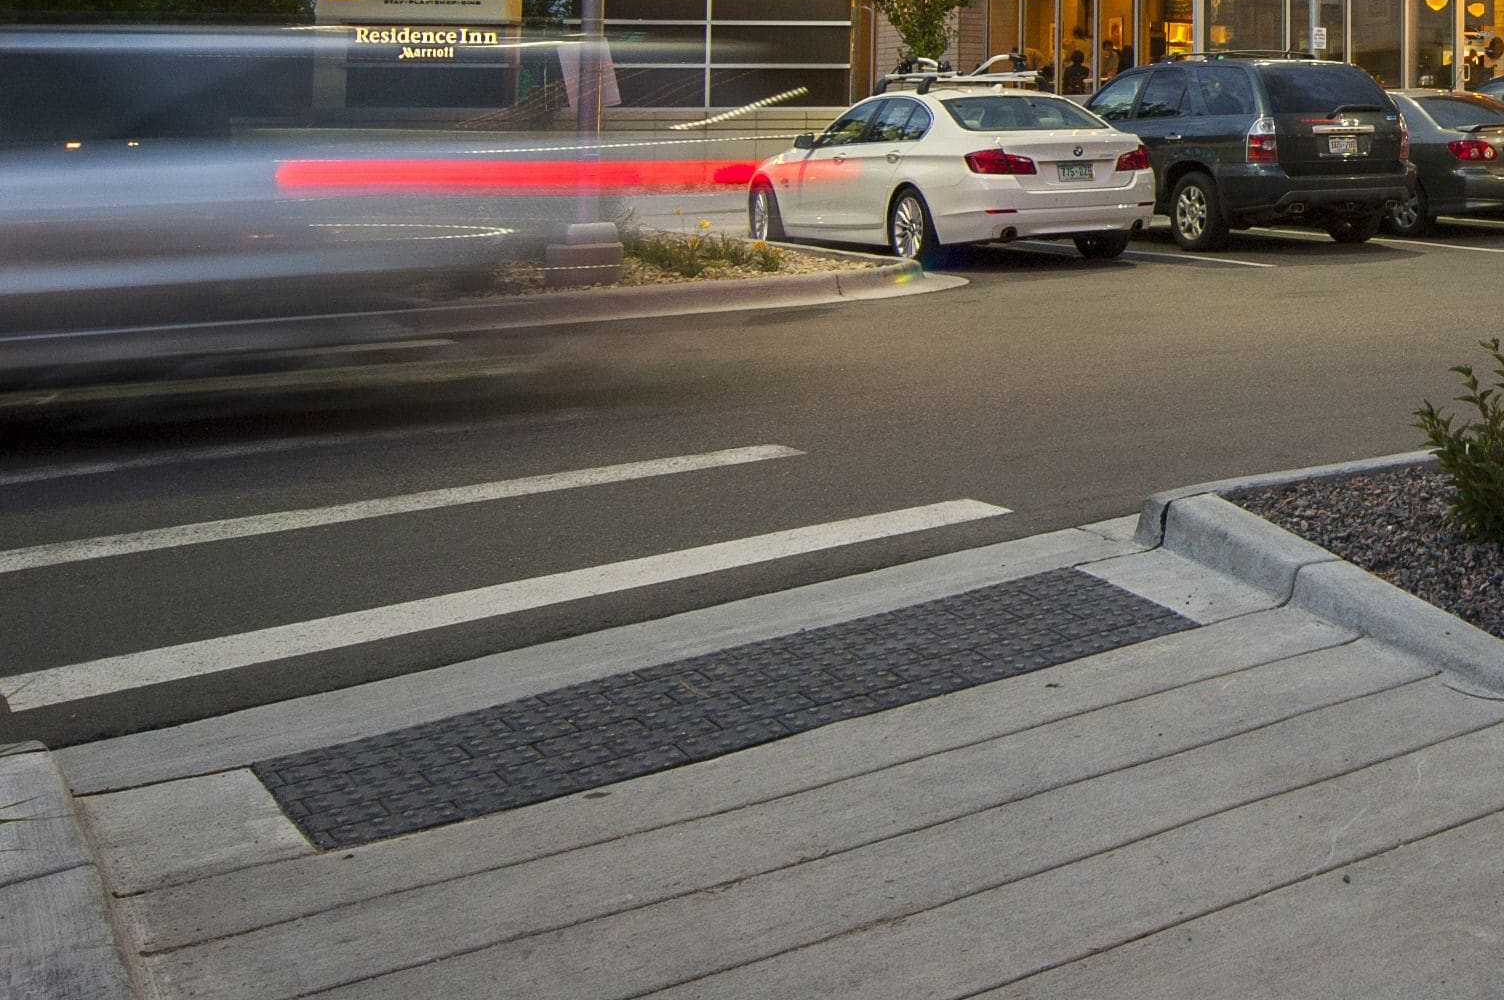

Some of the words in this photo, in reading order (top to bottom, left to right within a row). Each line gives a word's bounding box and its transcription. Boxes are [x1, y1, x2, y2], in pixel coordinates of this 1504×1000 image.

[355, 26, 457, 44] Residence
[460, 28, 498, 44] Inn
[398, 47, 454, 59] Marriott
